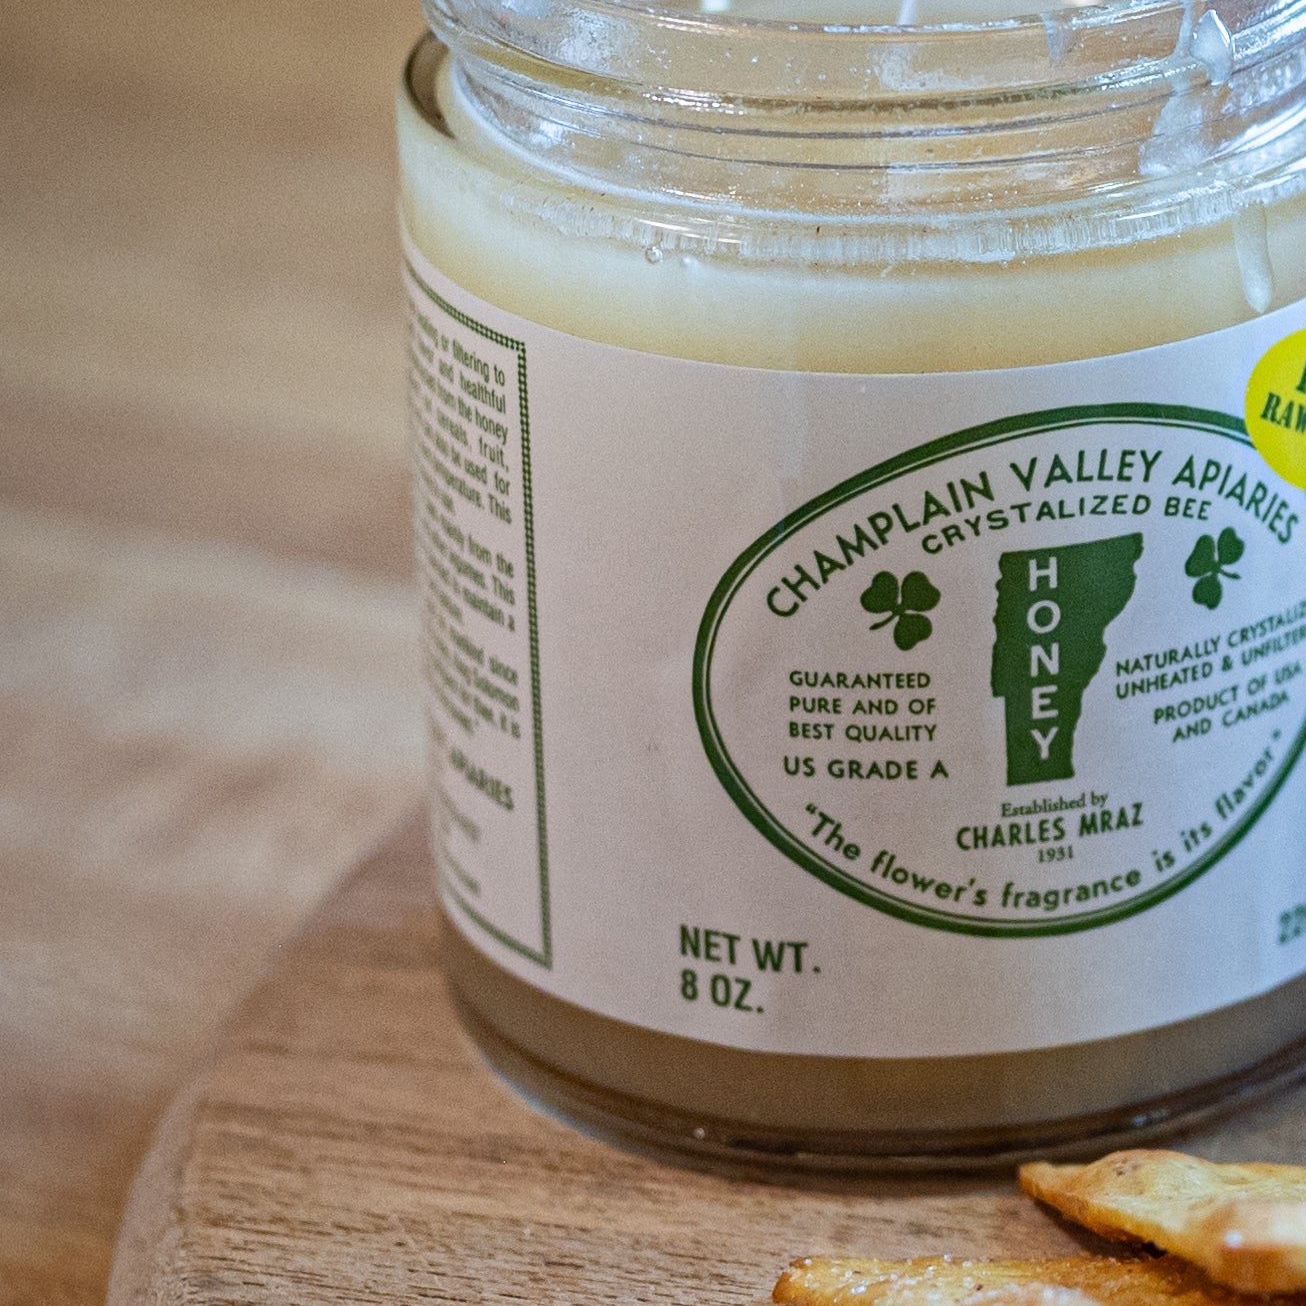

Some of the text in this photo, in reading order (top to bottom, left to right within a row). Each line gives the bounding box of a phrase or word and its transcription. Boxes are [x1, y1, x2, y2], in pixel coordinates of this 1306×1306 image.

[459, 372, 507, 414] healthful
[494, 363, 506, 387] to
[475, 405, 508, 446] honey
[479, 436, 510, 473] fruit,
[494, 470, 511, 496] for
[488, 492, 512, 525] This
[922, 494, 1212, 554] CRYSTALIZED BEE
[766, 449, 1299, 617] CHAMPLAIN VALLEY APIARIES
[1027, 556, 1061, 761] HONEY
[1116, 635, 1220, 677] NATURALLY
[1116, 661, 1213, 700] UNHEATED
[1221, 654, 1233, 672] &
[789, 670, 931, 689] GUARANTEED
[1154, 660, 1301, 724] PRODUCT OF USA
[789, 696, 936, 715] PURE AND OF
[1172, 690, 1289, 743] AND CANADA
[789, 721, 937, 743] BEST QUALITY
[784, 755, 949, 780] US GRADE A
[1001, 790, 1109, 818] Established by
[956, 801, 1144, 850] CHARLES MRAZ
[870, 849, 988, 907] flower's
[1001, 868, 1142, 912] fragrance
[1152, 849, 1176, 872] is
[1180, 821, 1213, 853] its
[1037, 844, 1074, 864] 1931
[680, 923, 822, 974] NET WT.
[681, 968, 764, 1014] 8 OZ.
